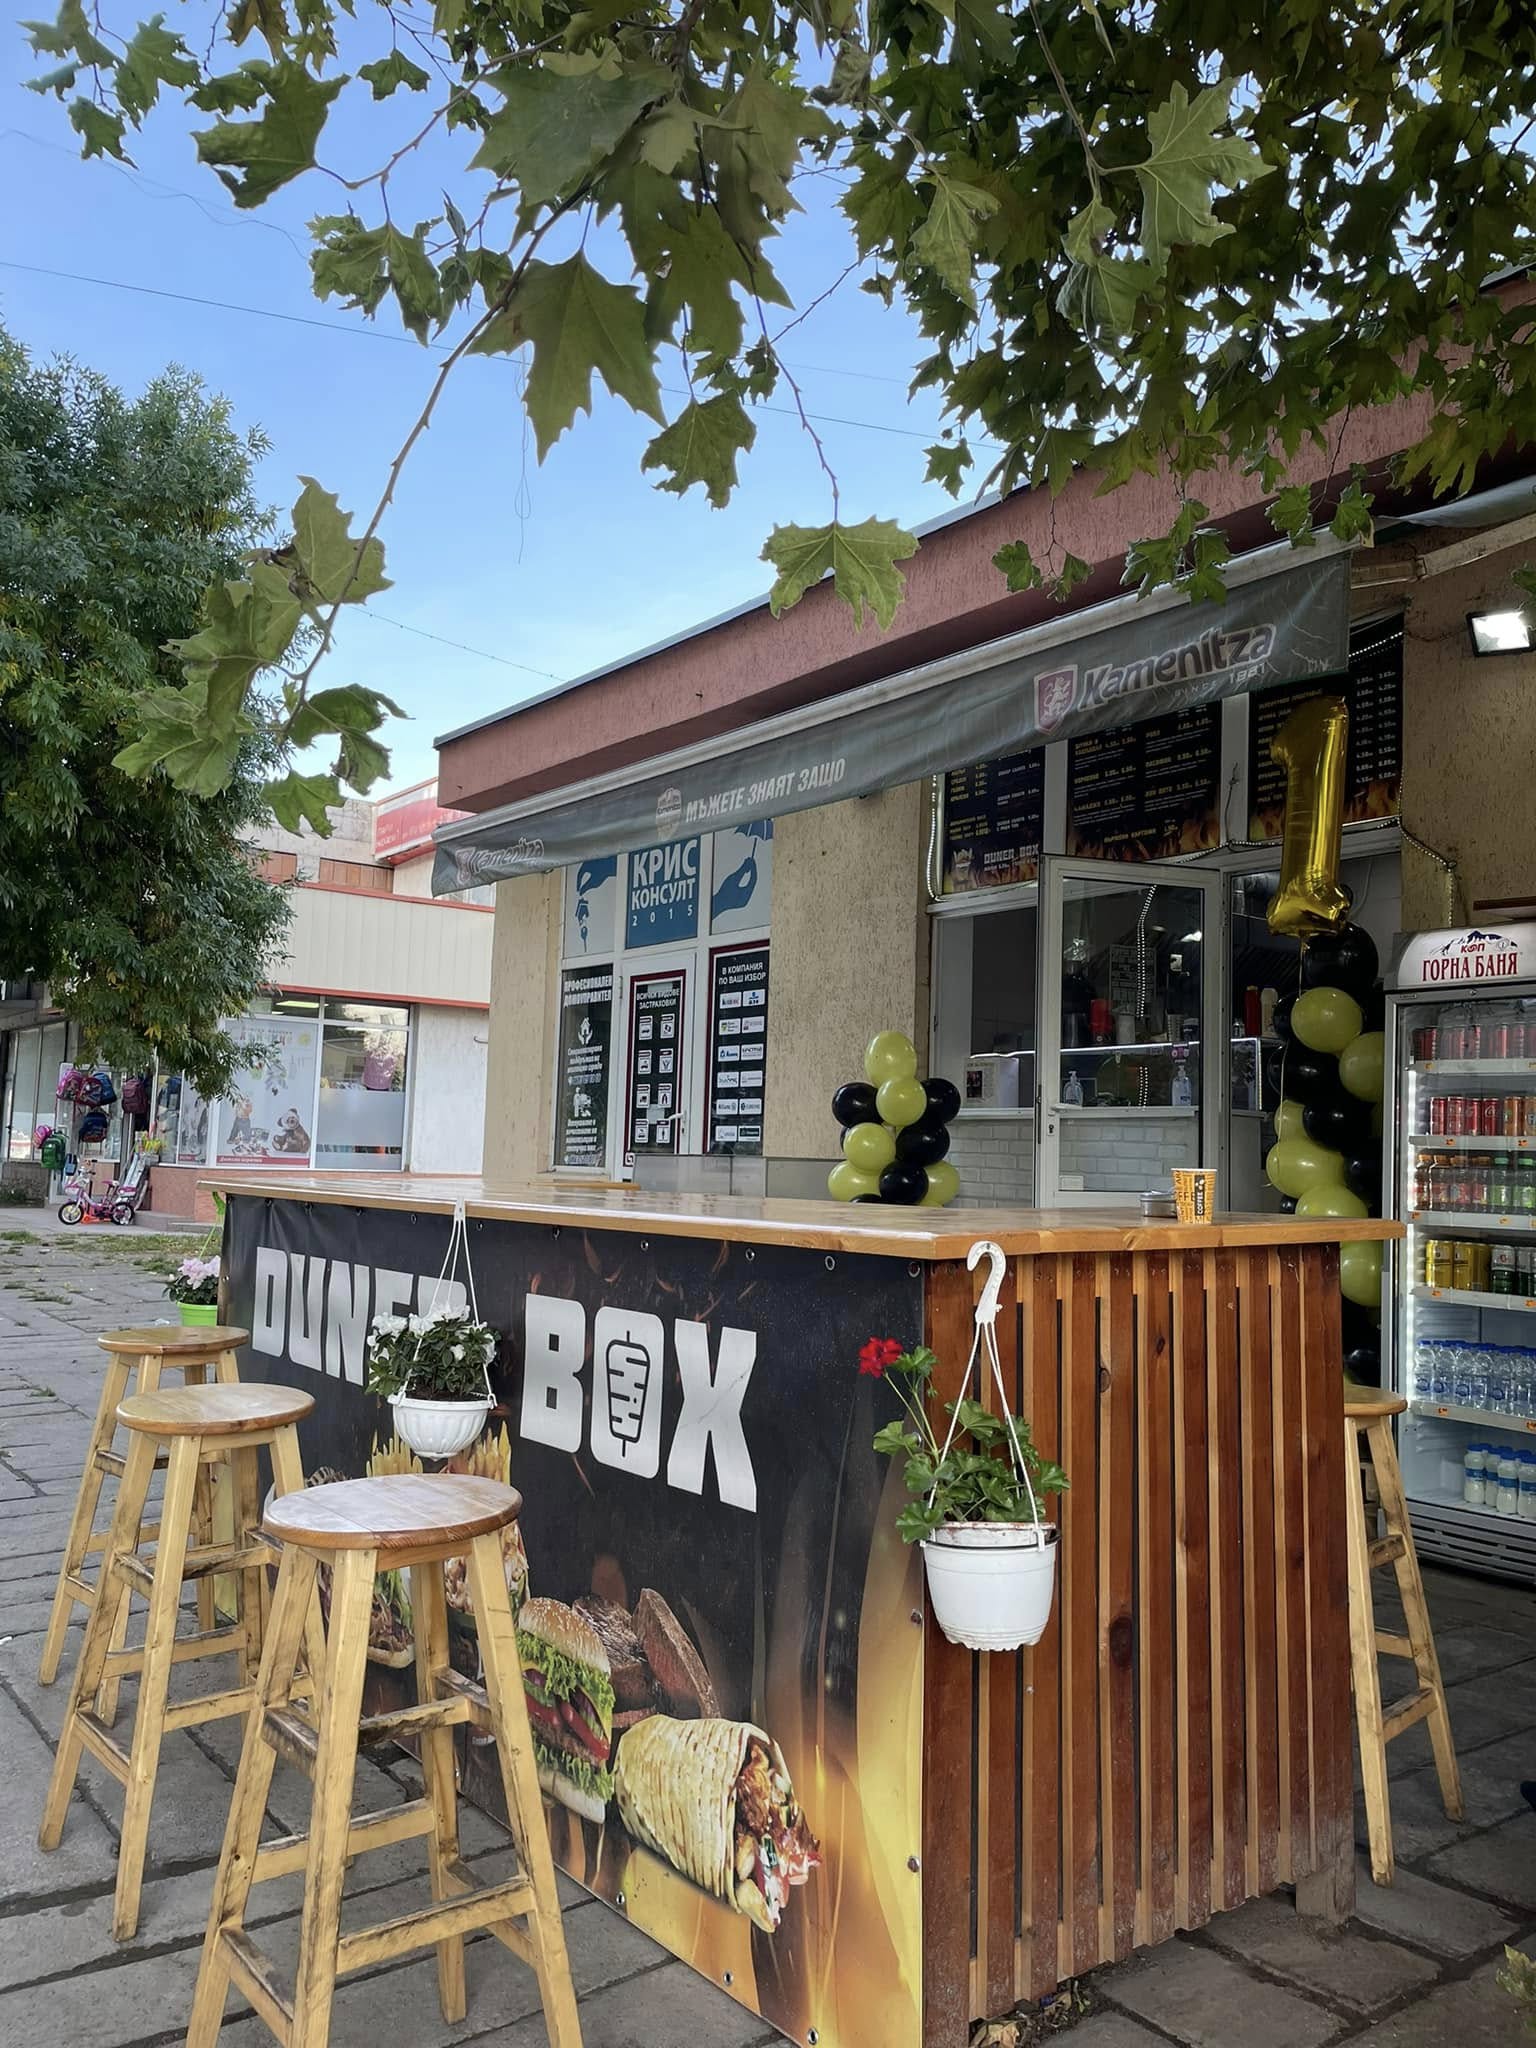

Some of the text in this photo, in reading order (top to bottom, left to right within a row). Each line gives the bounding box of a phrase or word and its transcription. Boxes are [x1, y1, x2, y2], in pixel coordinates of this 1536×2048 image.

[1078, 623, 1277, 711] Kamenitza
[685, 758, 846, 823] МЪЖЕТЕ ЗНАЯТ ЗАЩО
[633, 839, 698, 889] КРИС
[631, 878, 695, 911] КОНСУЛТ
[719, 972, 766, 985] ПО ВАШ ИЗБОР
[722, 962, 763, 975] В КОМПАНИЯ
[1423, 952, 1518, 981] ГОРНА БАНЯ
[639, 999, 676, 1010] ЗАСТРАХОВКИ
[521, 1293, 757, 1514] BOX
